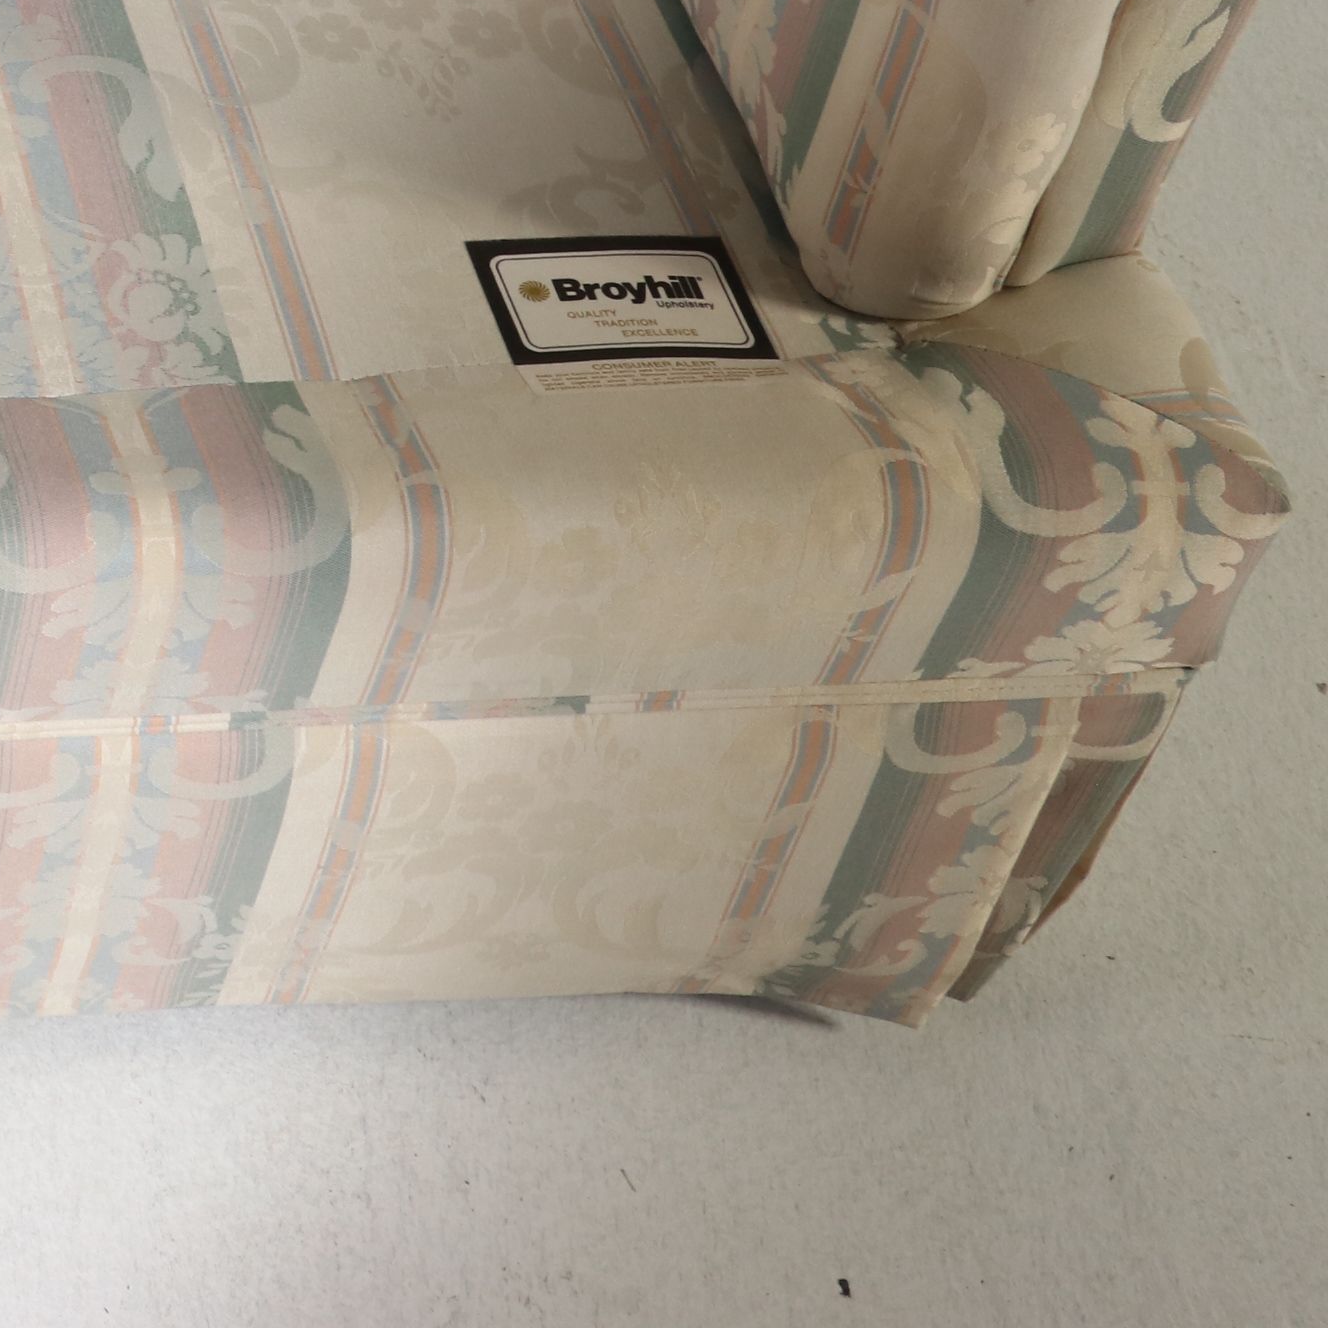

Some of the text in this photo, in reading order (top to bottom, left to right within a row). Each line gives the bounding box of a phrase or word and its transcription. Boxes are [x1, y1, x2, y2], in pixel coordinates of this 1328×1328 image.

[551, 275, 704, 303] Broyhill
[656, 300, 714, 310] Upholstery
[567, 309, 616, 318] QUALITY
[594, 319, 658, 327] TRADITION
[592, 360, 672, 370] CONSUMER
